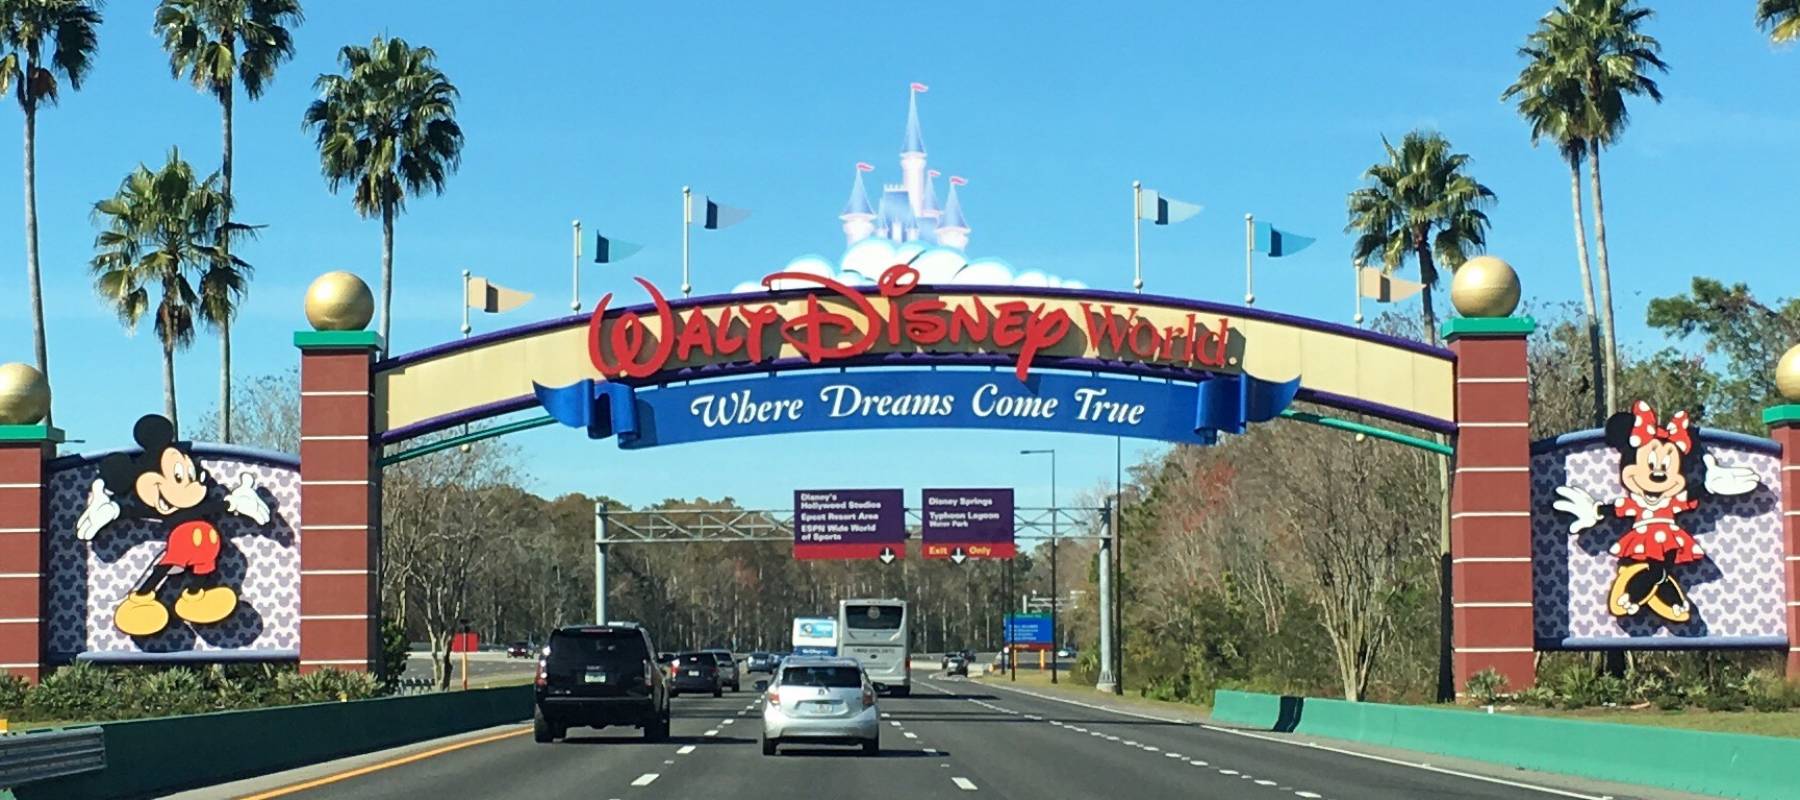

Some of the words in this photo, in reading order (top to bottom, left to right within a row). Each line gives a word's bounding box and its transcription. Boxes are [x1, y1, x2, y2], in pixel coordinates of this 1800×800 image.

[690, 390, 804, 428] Where
[820, 384, 954, 418] Dreams
[972, 383, 1058, 418] Come
[1074, 388, 1145, 425] True
[800, 493, 837, 502] Disney's
[928, 497, 958, 507] Disney
[959, 497, 993, 507] Springs
[800, 501, 847, 510] Hollywood
[848, 501, 882, 509] Studios
[801, 513, 827, 522] Epcot
[858, 512, 879, 520] Area
[929, 511, 966, 521] Typhoon
[967, 511, 1000, 521] Lagoon
[801, 524, 826, 532] ESPN
[827, 524, 849, 532] Wide
[850, 524, 877, 532] World
[951, 520, 969, 528] Park
[801, 533, 811, 541] of
[813, 533, 842, 542] Sports
[928, 546, 948, 555] Exit
[968, 545, 992, 556] Only
